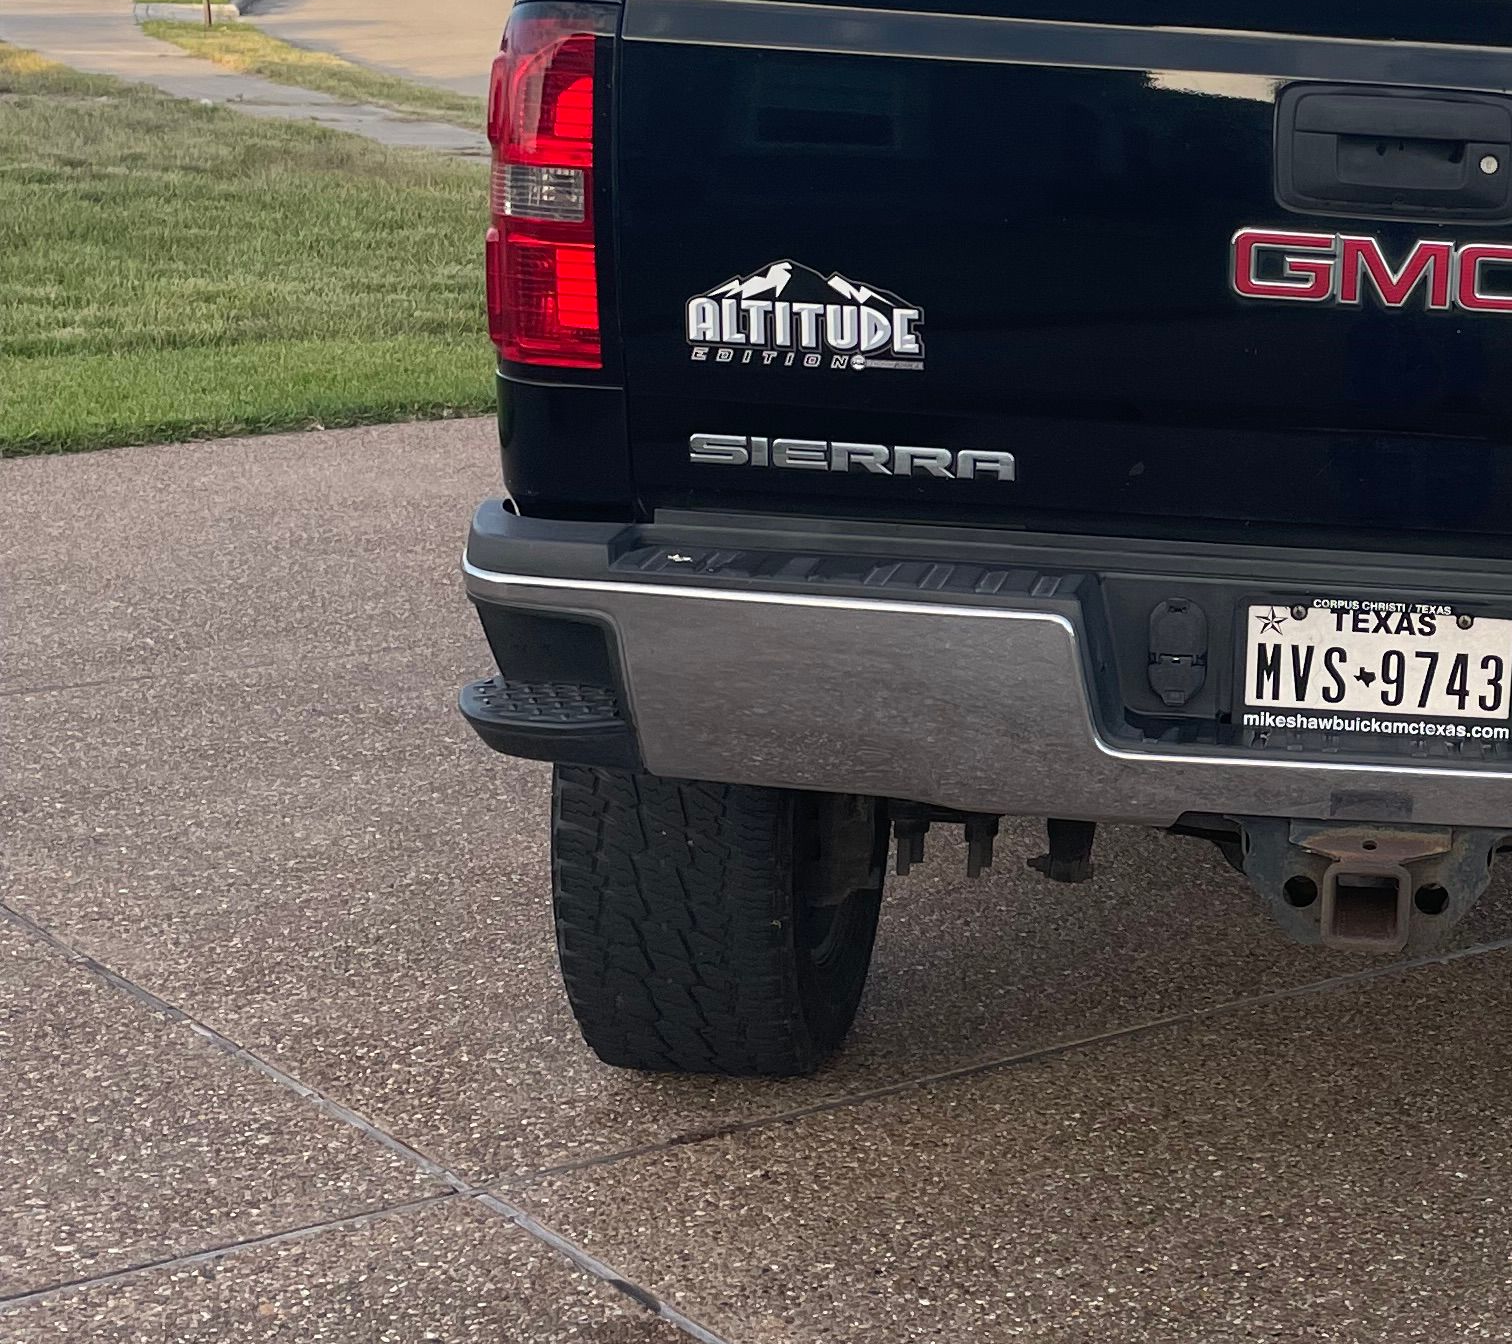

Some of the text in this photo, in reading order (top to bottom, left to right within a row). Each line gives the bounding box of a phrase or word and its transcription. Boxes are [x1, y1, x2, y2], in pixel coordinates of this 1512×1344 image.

[688, 297, 920, 354] ALTITUDE
[691, 346, 848, 369] EDITION
[689, 432, 1016, 482] SIERRA
[1313, 598, 1360, 610] CORPUS
[1361, 601, 1406, 613] CHRISTI
[1415, 604, 1452, 616] TEXAS
[1330, 609, 1437, 637] TEXAS
[1255, 642, 1504, 712] MVS 9743
